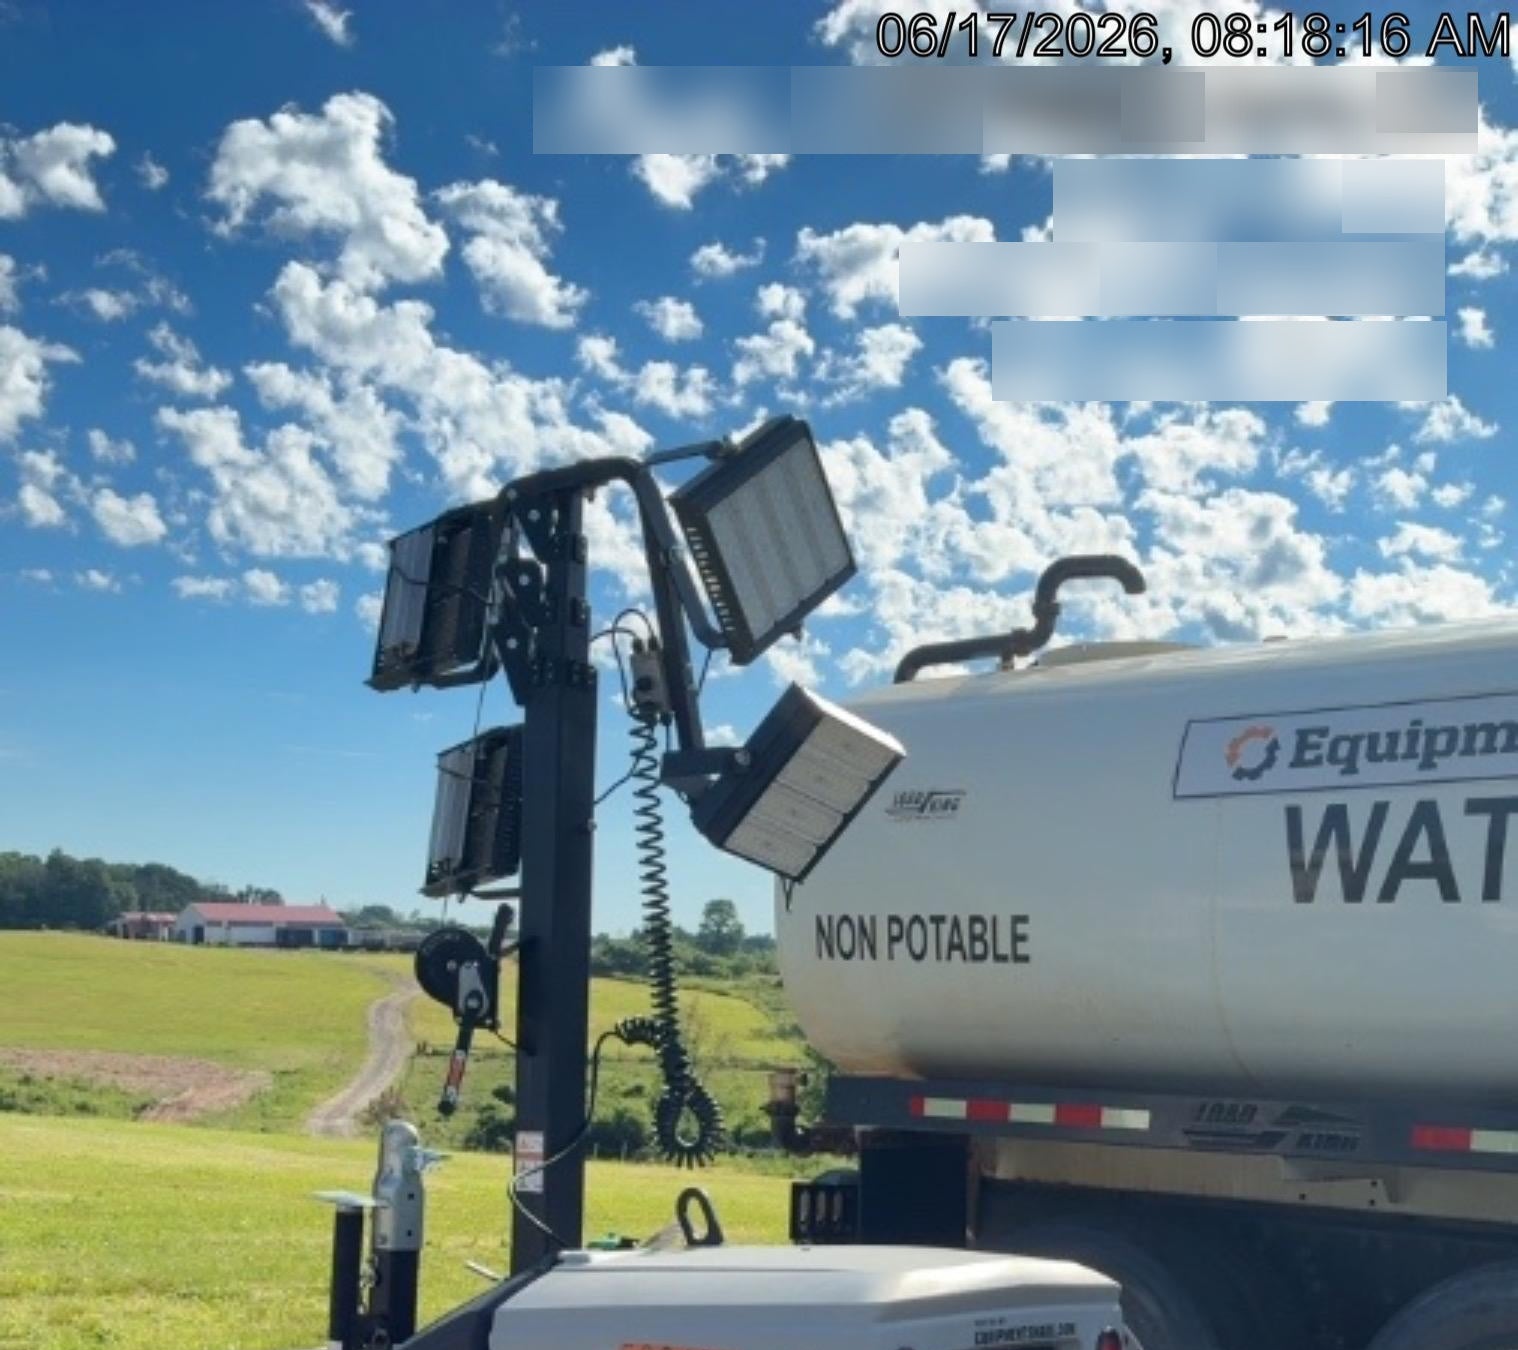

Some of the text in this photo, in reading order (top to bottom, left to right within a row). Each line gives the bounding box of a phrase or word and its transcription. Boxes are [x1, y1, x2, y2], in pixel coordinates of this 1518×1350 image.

[1284, 796, 1518, 904] WAT
[815, 914, 1031, 964] NON POTABLE
